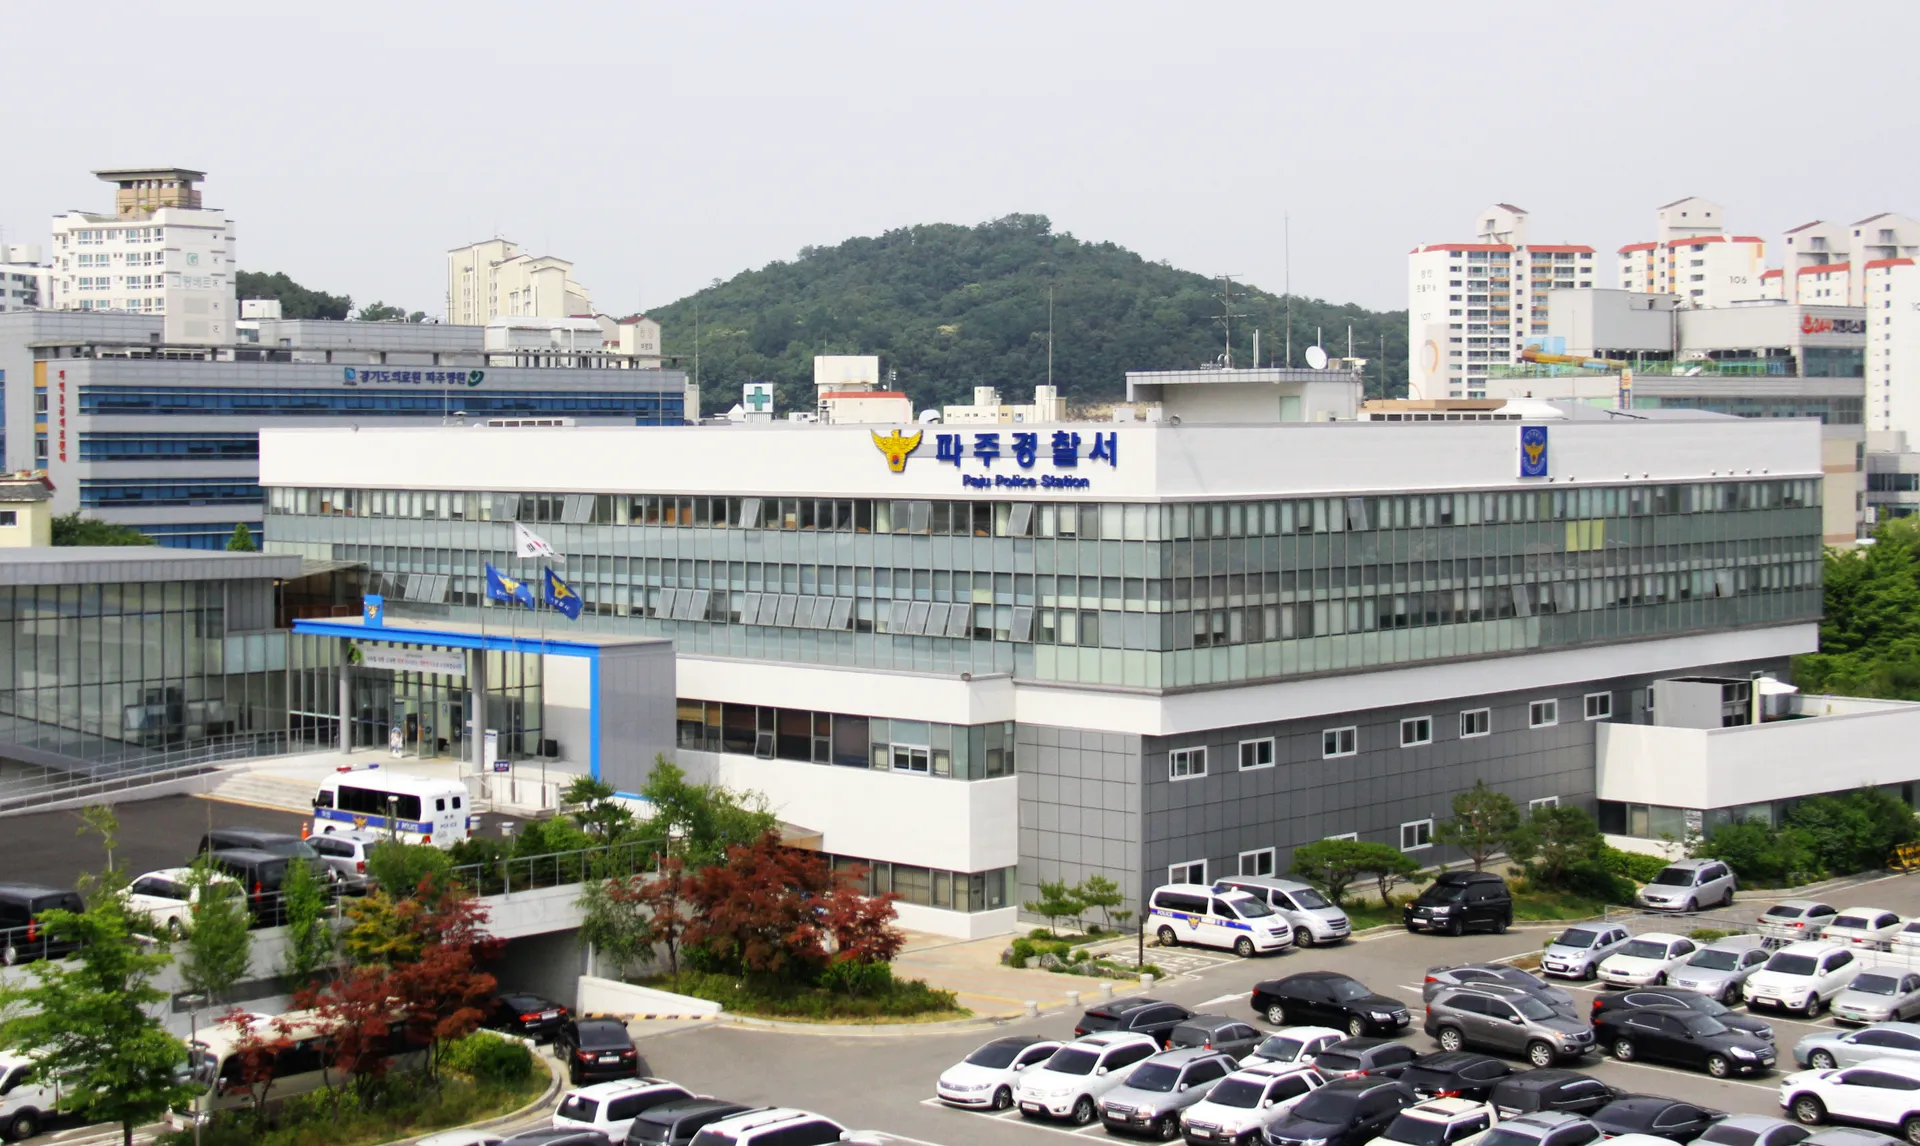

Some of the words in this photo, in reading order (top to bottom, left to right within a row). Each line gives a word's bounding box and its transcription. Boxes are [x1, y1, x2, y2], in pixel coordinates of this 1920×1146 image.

[1729, 275, 1747, 285] 106
[360, 370, 421, 384] 경기도의료원
[425, 371, 466, 384] 파주병원
[935, 430, 1117, 468] 파주경찰서
[963, 474, 991, 488] Paju
[995, 475, 1037, 488] Police
[1041, 475, 1090, 488] Station
[1157, 909, 1173, 917] POLICE
